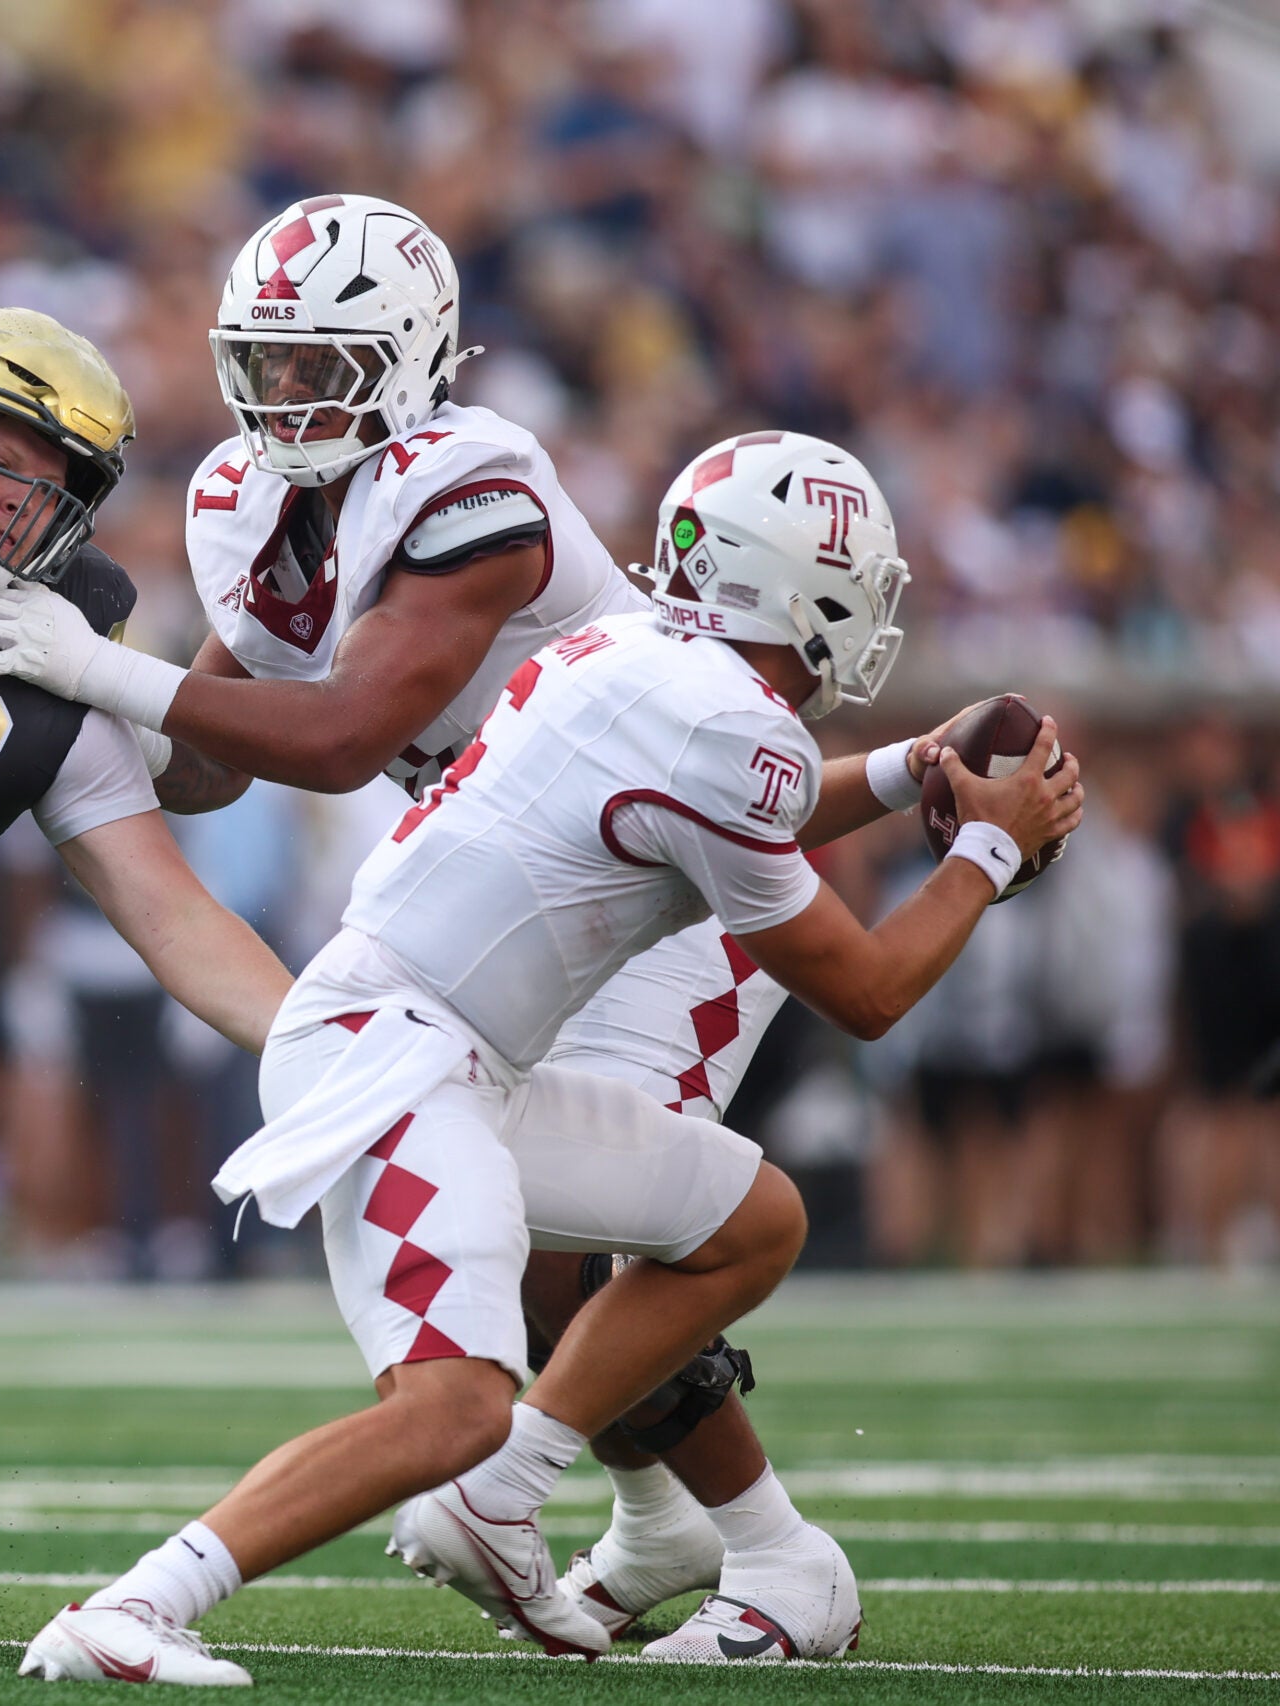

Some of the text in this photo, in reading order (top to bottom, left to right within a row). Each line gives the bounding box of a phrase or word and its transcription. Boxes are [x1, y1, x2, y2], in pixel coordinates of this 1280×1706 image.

[251, 306, 296, 320] OWLS
[287, 413, 306, 426] TUF
[374, 430, 455, 482] 71
[676, 527, 694, 539] C2P
[802, 476, 868, 571] T
[695, 559, 708, 575] 6
[745, 745, 803, 825] T
[929, 806, 959, 847] T
